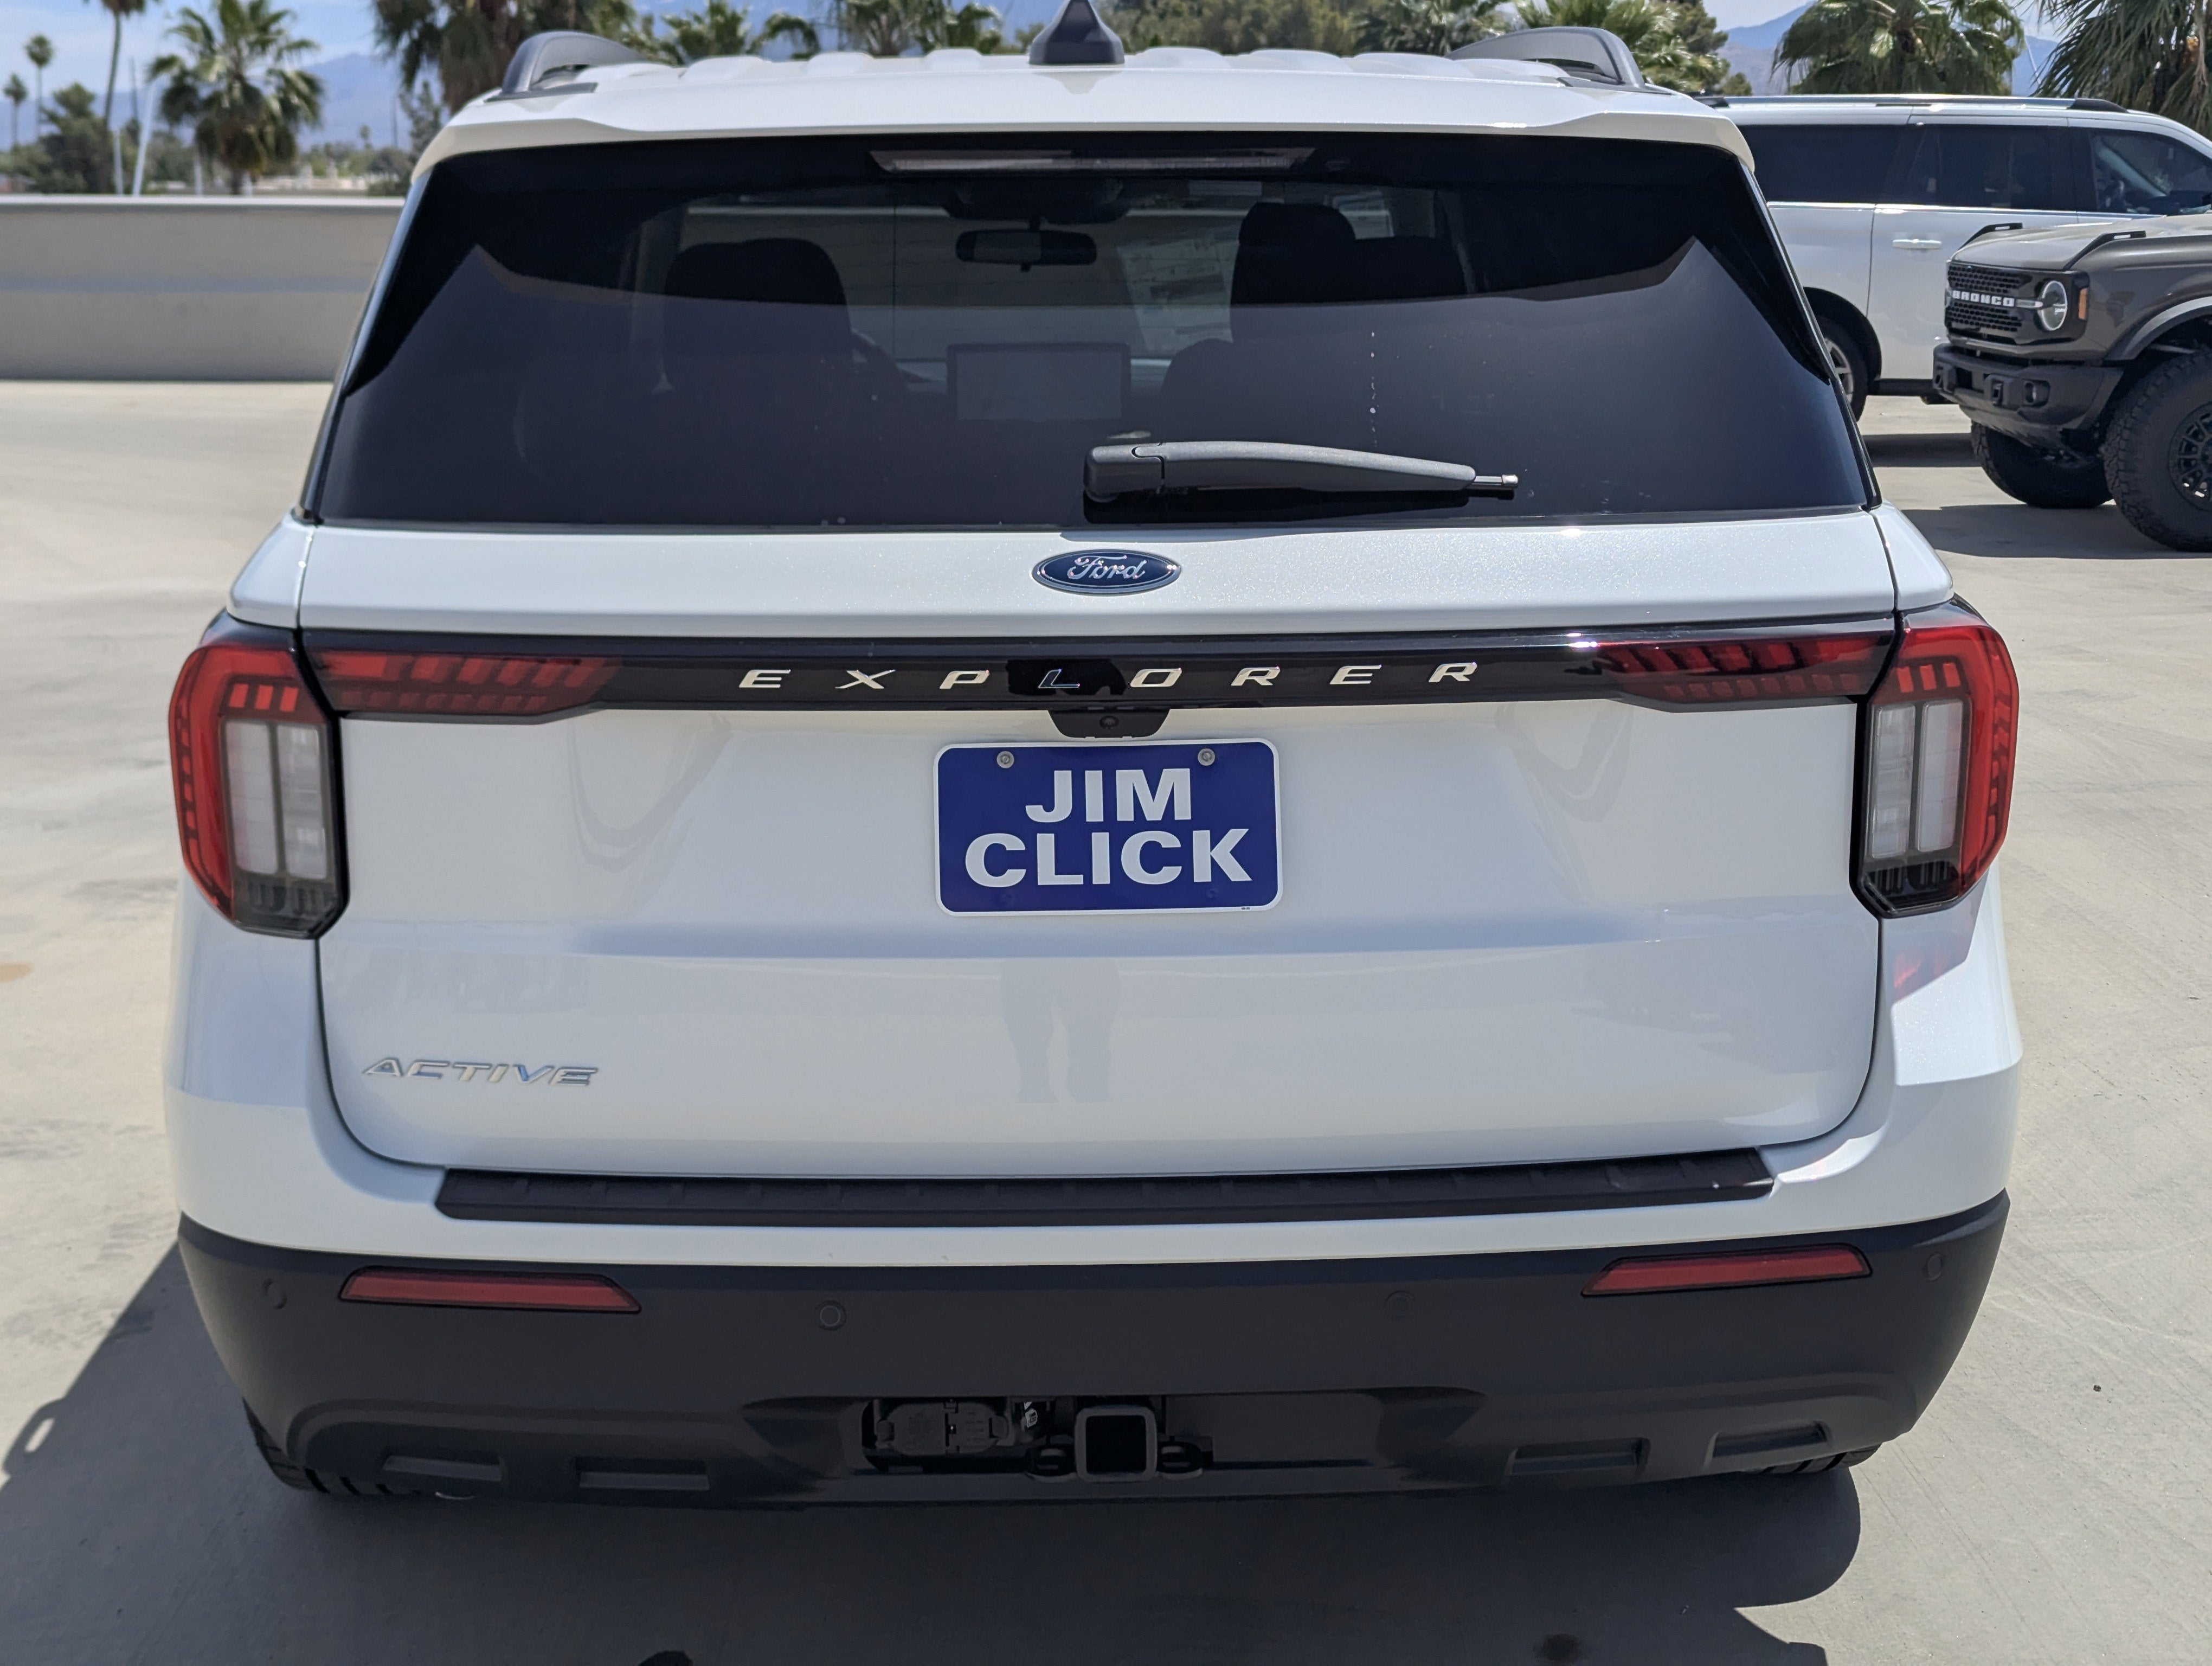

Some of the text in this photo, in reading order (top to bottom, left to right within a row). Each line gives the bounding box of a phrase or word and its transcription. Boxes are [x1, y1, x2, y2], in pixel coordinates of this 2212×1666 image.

[1952, 290, 2015, 307] BRONCO
[1067, 555, 1147, 579] Ford
[738, 661, 1478, 689] EXPLORER
[1025, 768, 1192, 823] JIM
[965, 828, 1252, 887] CLICK
[362, 1056, 599, 1086] ACTIVE
